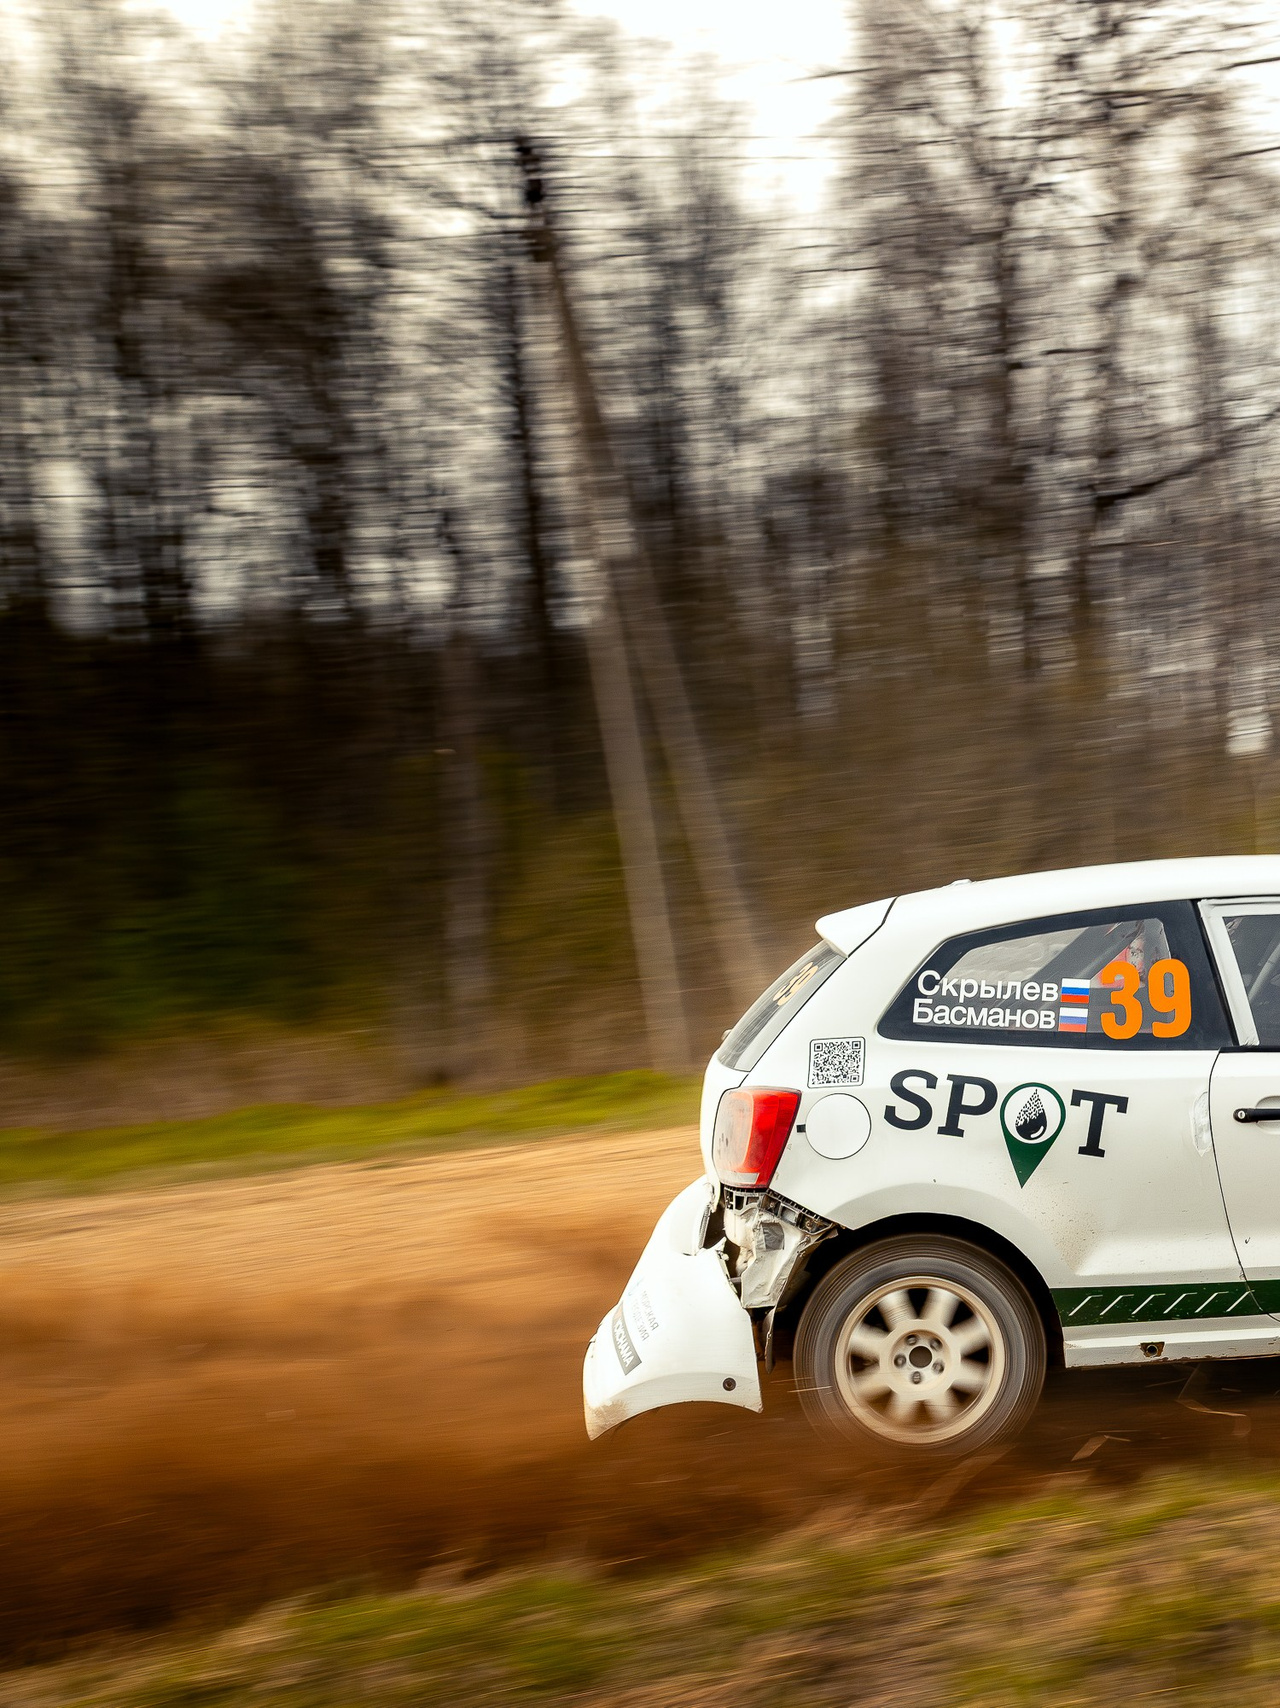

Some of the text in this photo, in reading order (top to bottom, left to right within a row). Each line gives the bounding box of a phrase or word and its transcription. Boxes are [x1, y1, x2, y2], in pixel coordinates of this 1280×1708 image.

[772, 961, 819, 1006] 39
[917, 969, 1059, 1003] Скрылев
[1100, 958, 1192, 1041] 39
[912, 998, 1056, 1030] Басманов
[883, 1068, 1129, 1188] SPOT
